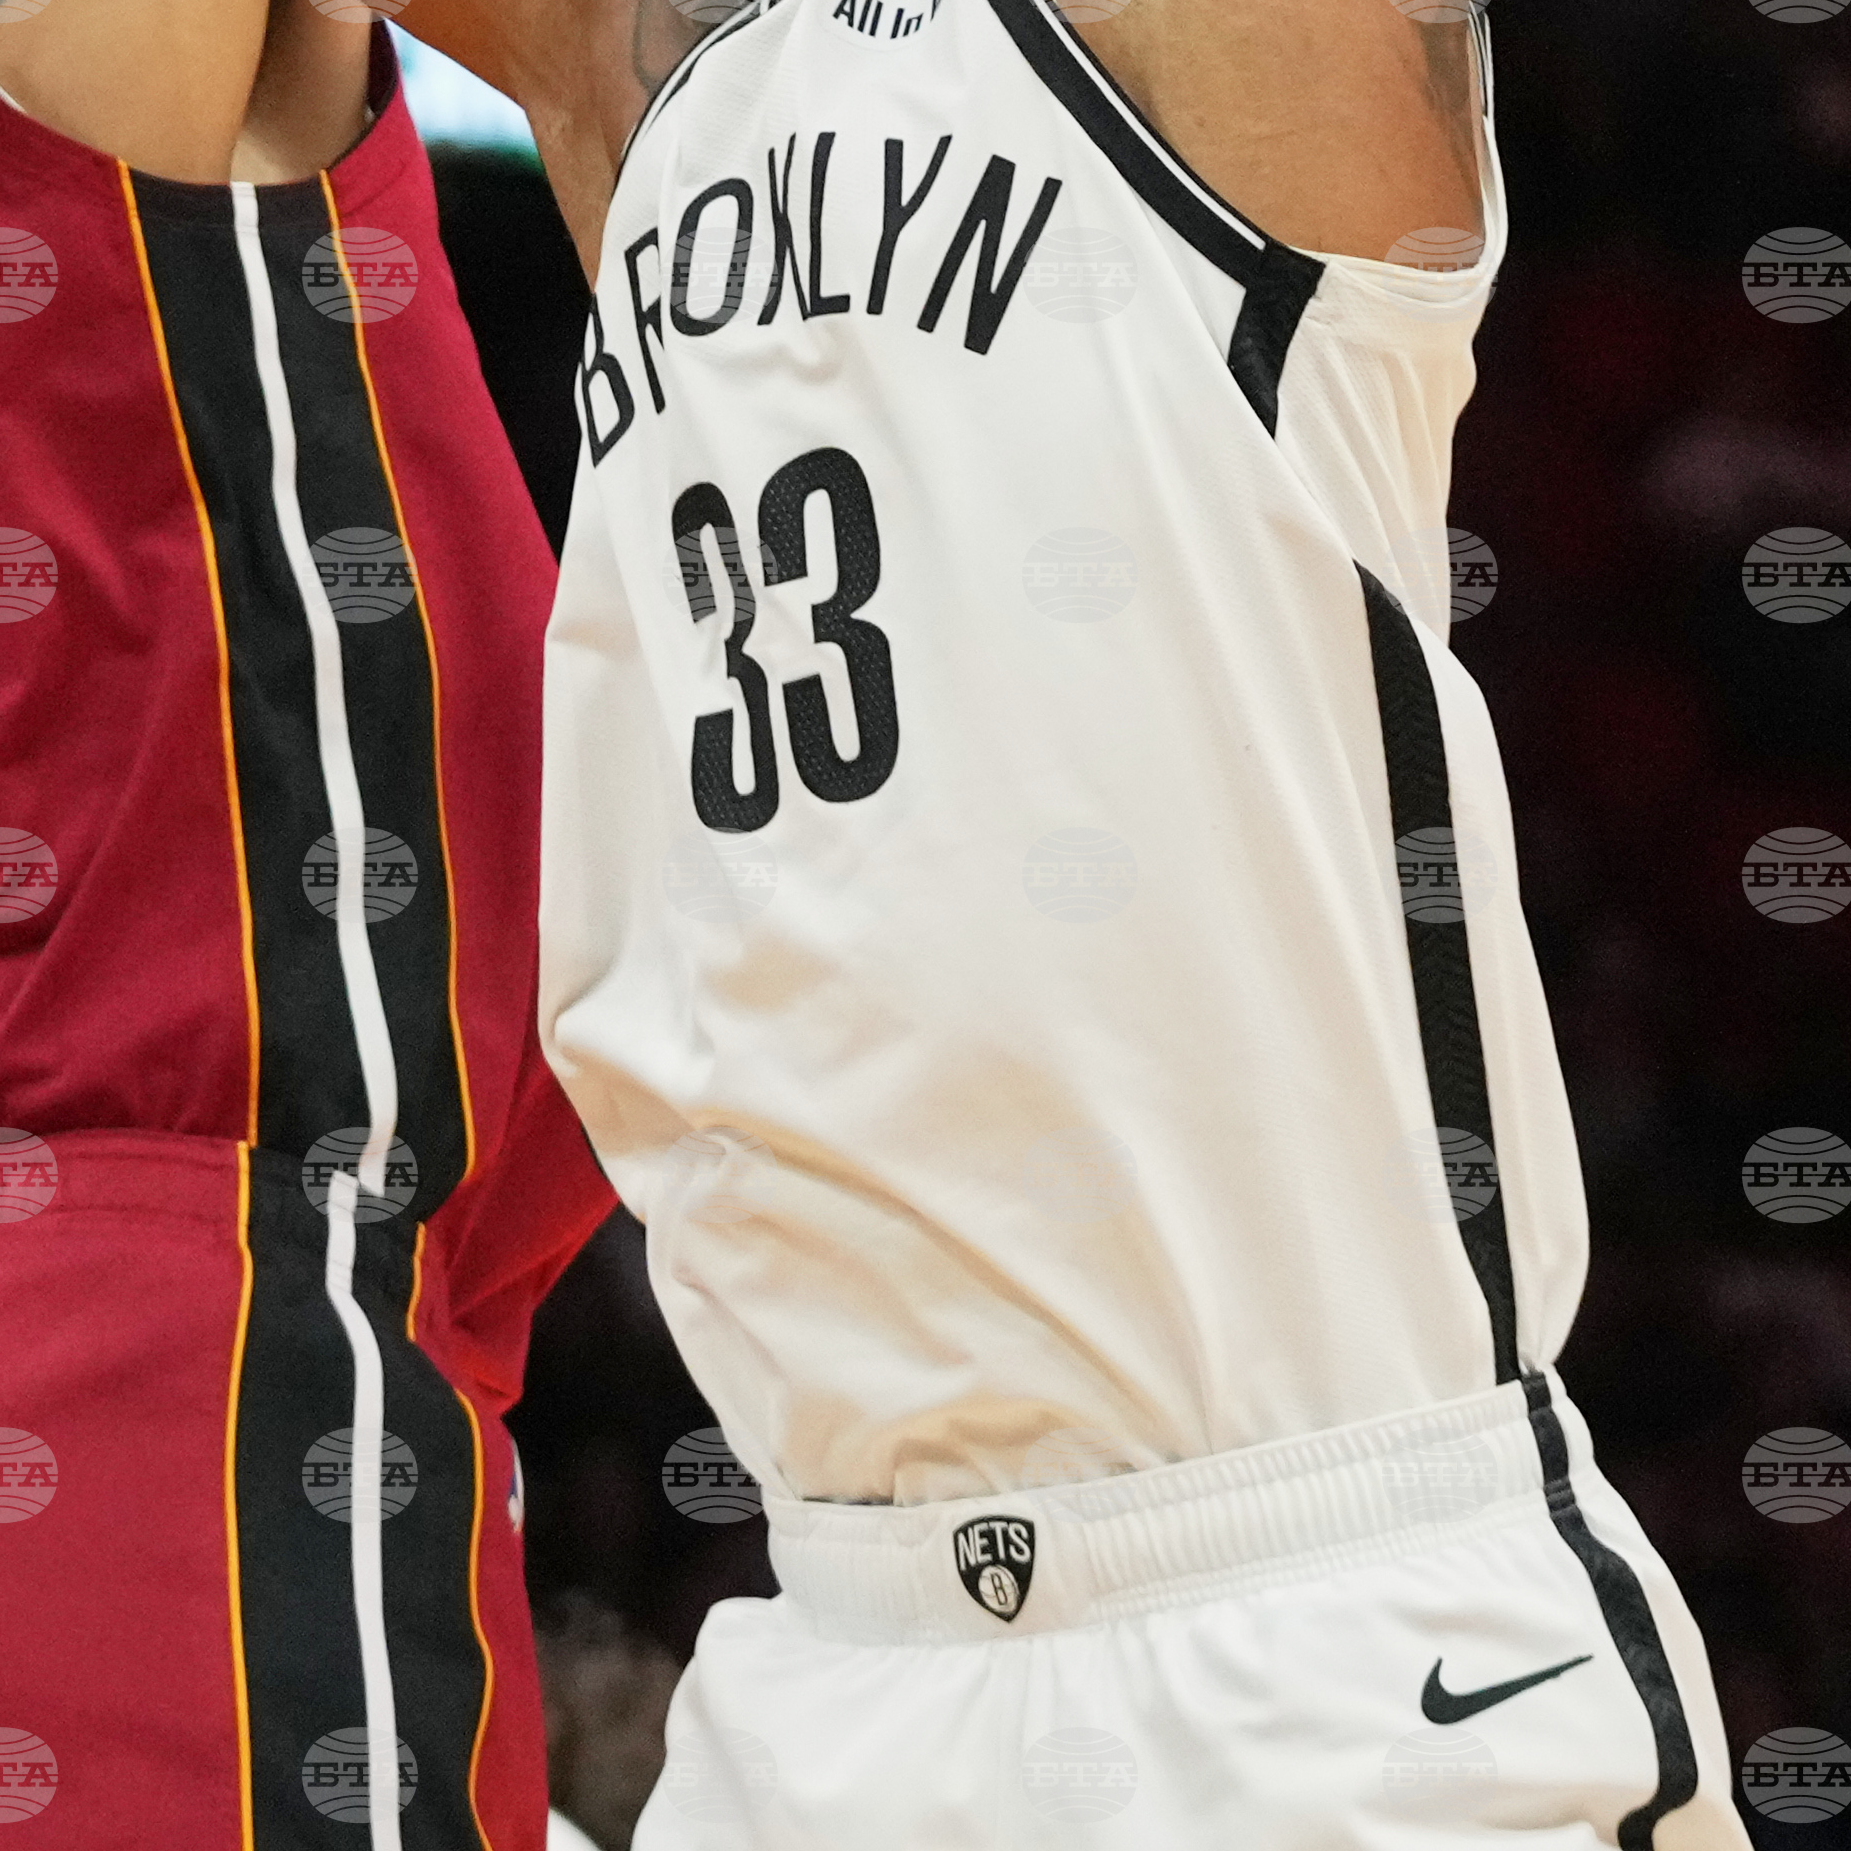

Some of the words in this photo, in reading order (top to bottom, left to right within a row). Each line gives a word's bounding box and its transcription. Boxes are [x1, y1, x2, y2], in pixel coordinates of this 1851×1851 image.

[889, 7, 924, 40] In
[672, 447, 900, 834] 33
[957, 1521, 1032, 1572] NETS
